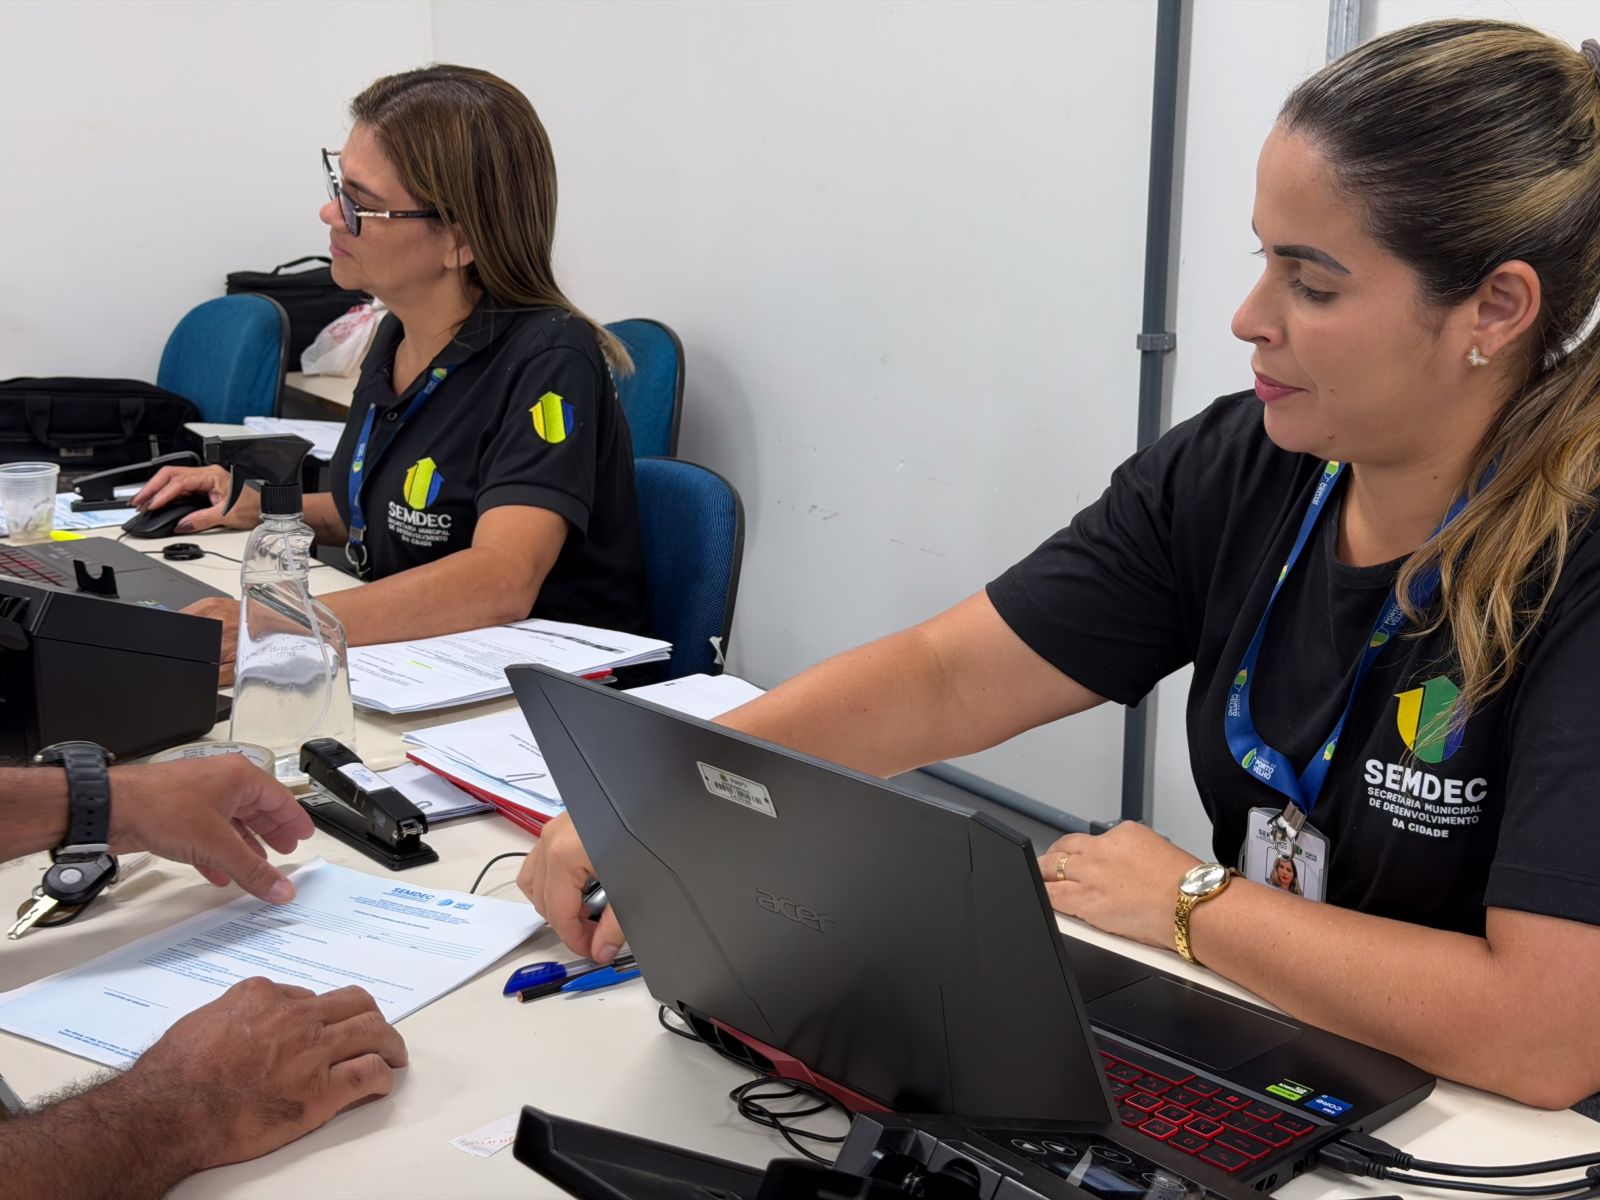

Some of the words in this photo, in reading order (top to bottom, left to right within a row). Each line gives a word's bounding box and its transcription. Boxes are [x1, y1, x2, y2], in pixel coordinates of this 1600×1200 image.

[388, 501, 452, 529] SEMDEC
[1364, 759, 1488, 804] SEMDEC
[1367, 786, 1422, 810] SECRETARIA
[1424, 802, 1483, 816] MUNICIPAL
[1369, 797, 1381, 809] DE
[1382, 802, 1479, 826] DESENVOLVIMENTO
[1391, 818, 1406, 830] DA
[1408, 822, 1450, 838] CIDADE
[392, 888, 435, 900] SEMDEC
[756, 887, 835, 934] acer
